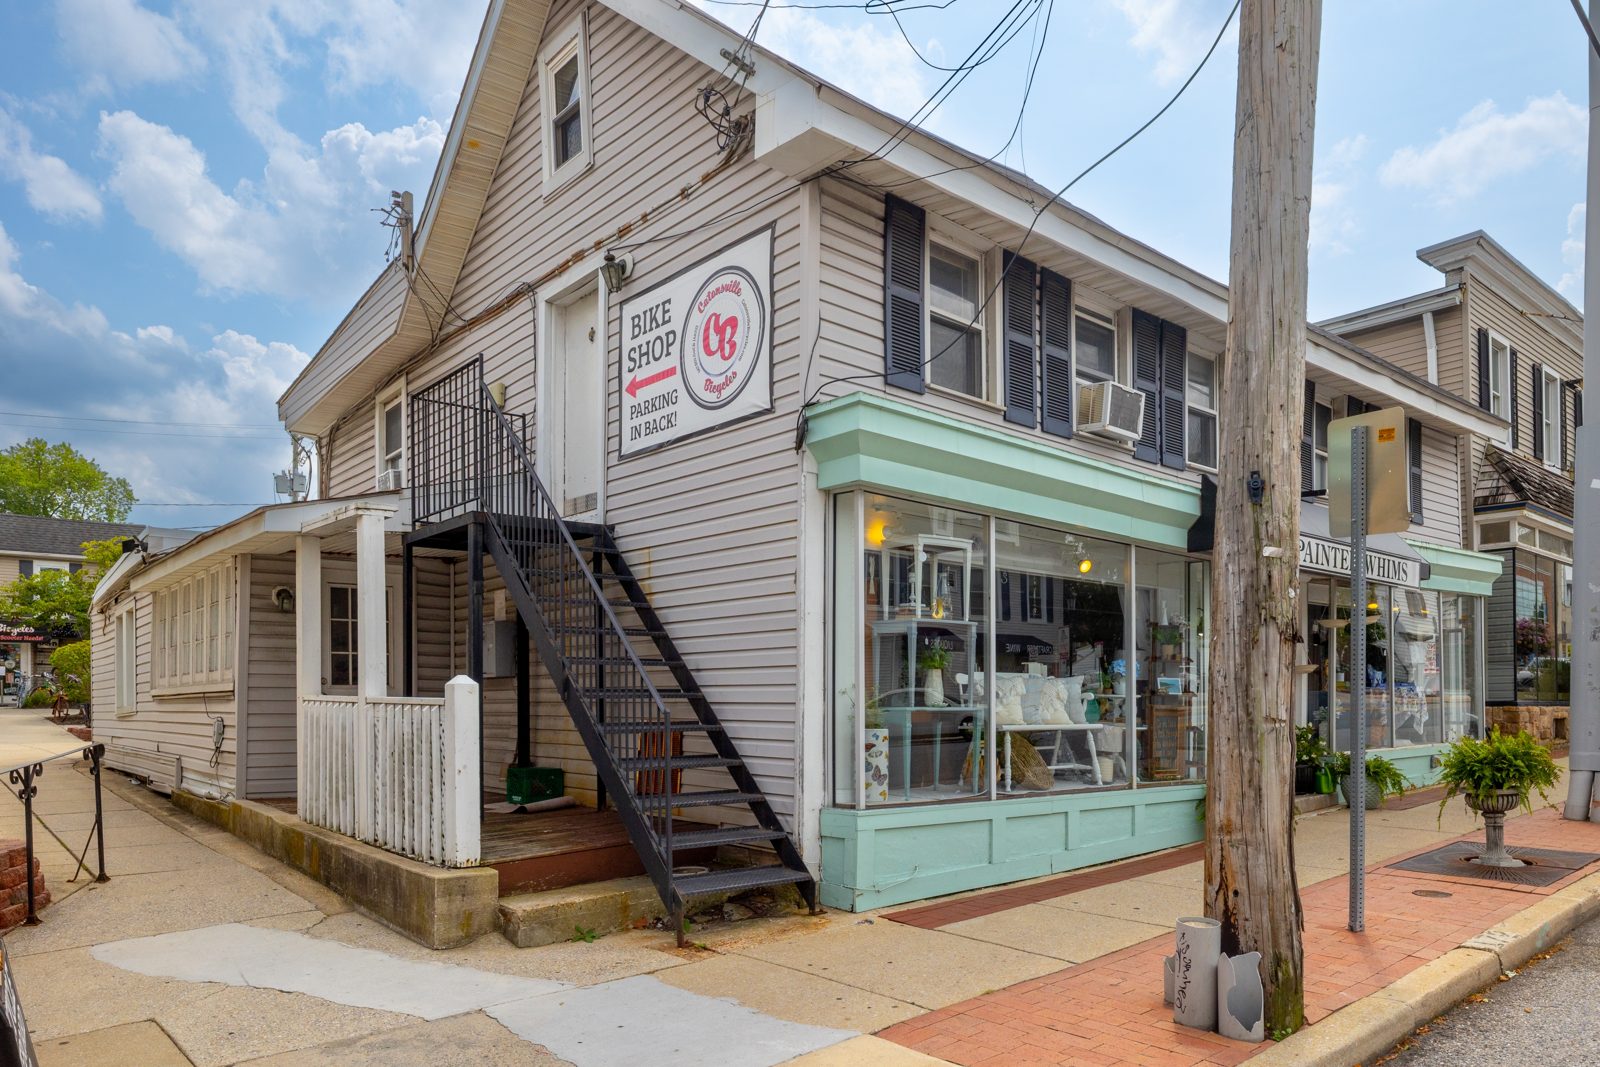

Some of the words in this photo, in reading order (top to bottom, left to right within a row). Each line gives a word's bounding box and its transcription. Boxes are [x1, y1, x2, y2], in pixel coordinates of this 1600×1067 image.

[698, 280, 742, 314] Catonsville
[630, 298, 672, 340] BIKE
[627, 329, 677, 373] SHOP
[704, 370, 737, 399] Bicycles
[630, 389, 678, 420] PARKING
[630, 424, 642, 441] IN
[644, 411, 677, 436] BACK!
[1366, 554, 1408, 582] WHIMS
